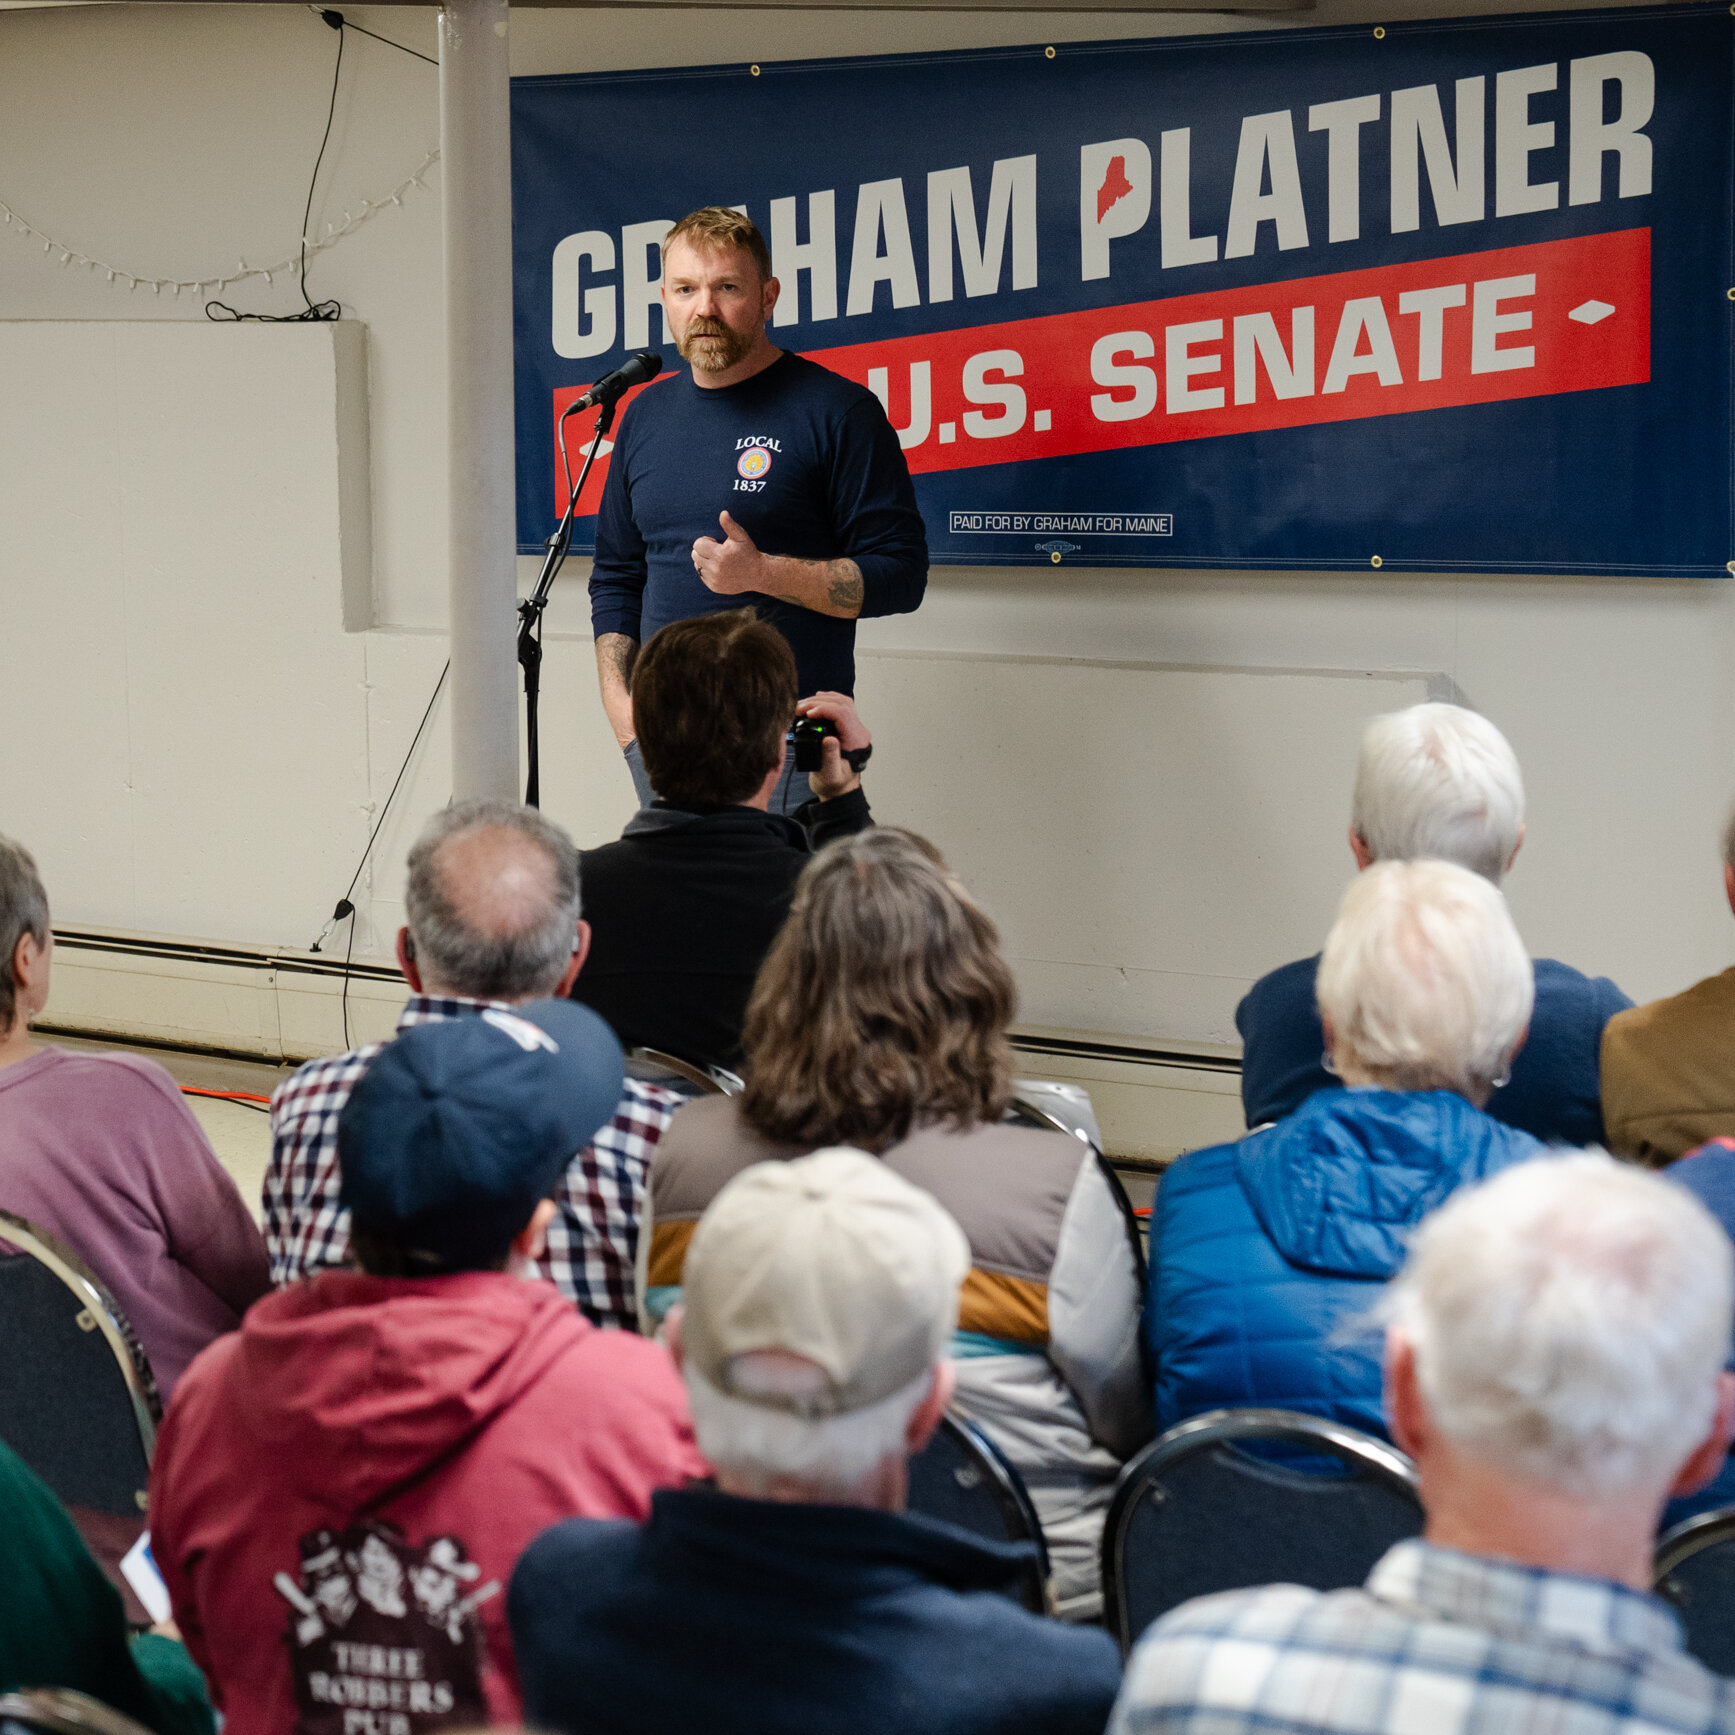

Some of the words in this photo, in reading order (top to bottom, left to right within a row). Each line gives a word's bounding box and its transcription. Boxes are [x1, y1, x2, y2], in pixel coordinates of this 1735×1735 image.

[552, 154, 1038, 360] GRHAM
[1080, 50, 1655, 282] PLATNER
[867, 348, 1051, 450] U.S.
[1090, 273, 1536, 422] SENATE
[734, 435, 783, 453] LOCAL
[732, 479, 767, 493] 1837
[953, 515, 981, 529] PAID
[985, 516, 1010, 530] FOR
[1013, 516, 1031, 530] BY
[1034, 516, 1092, 531] GRAHAM
[1096, 518, 1122, 531] FOR
[1125, 518, 1168, 532] MAINE
[331, 1641, 425, 1679] THREE
